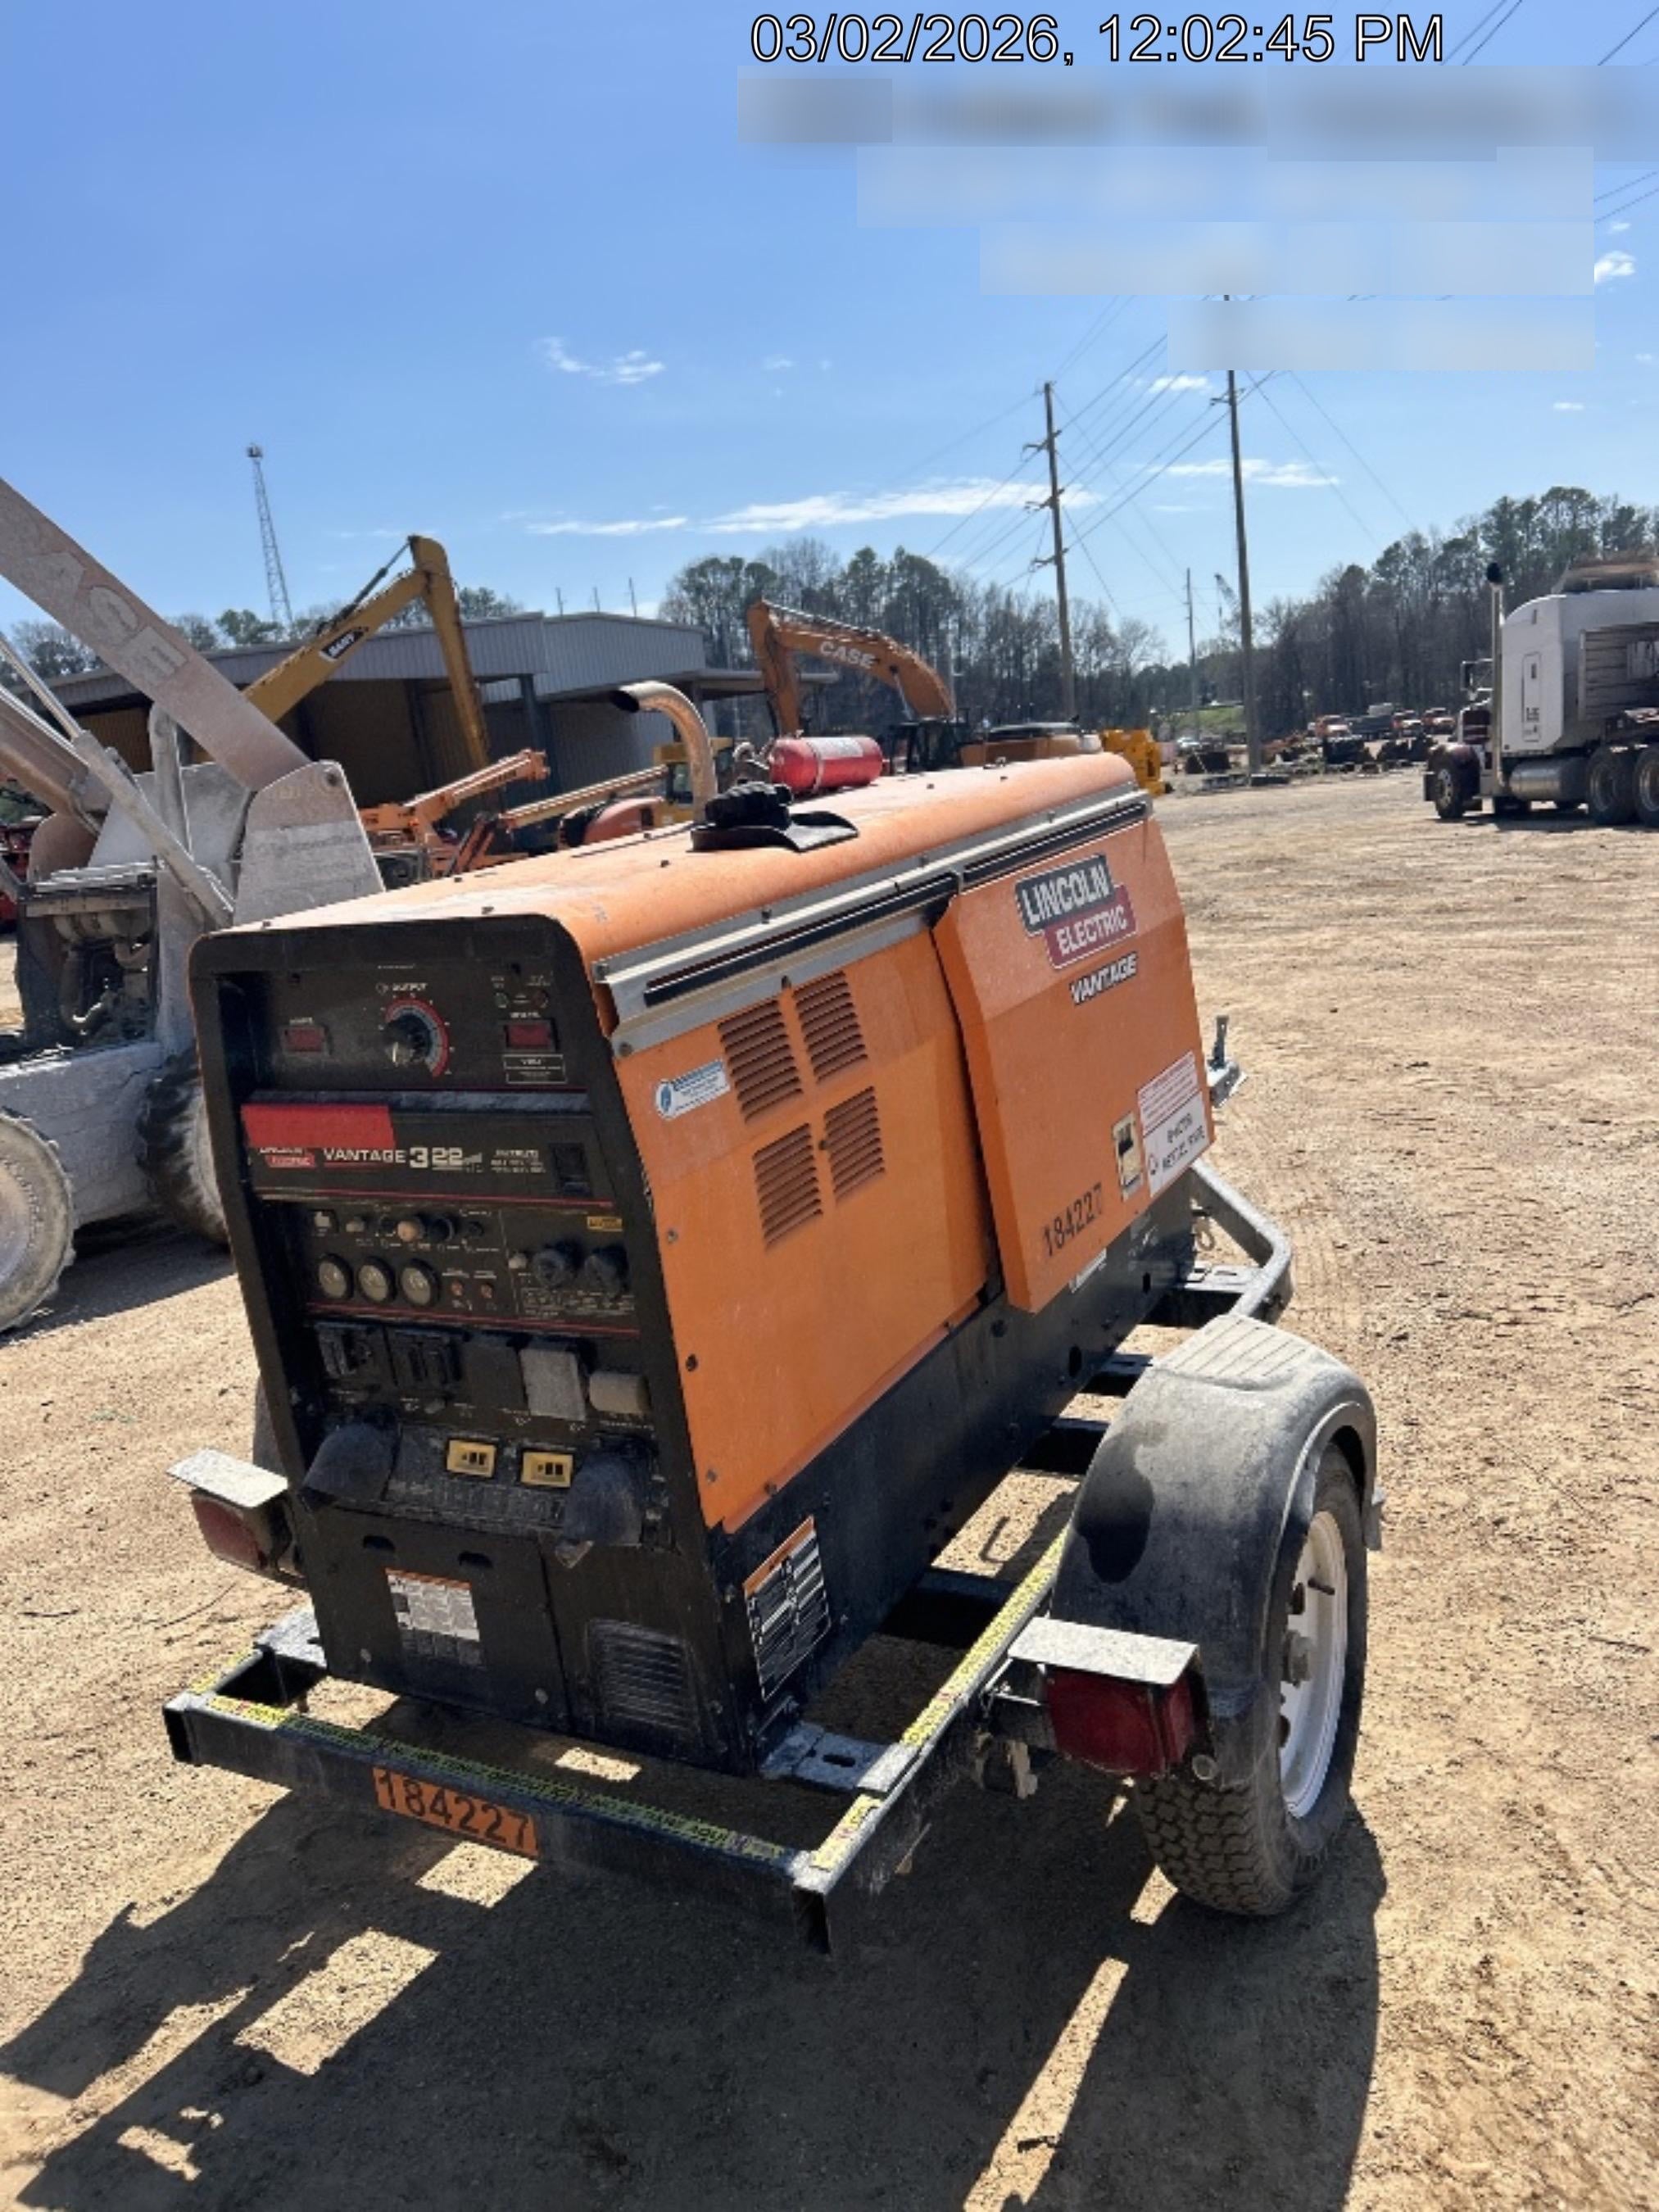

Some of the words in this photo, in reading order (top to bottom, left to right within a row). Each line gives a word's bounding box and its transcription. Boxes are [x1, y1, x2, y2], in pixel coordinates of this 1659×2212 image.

[819, 641, 876, 669] CASE
[1021, 863, 1111, 926] LINCOLN
[1055, 904, 1128, 957] ELECTRIC
[1070, 952, 1138, 1005] VANTAGE
[322, 1148, 407, 1164] VANTAGE
[409, 1147, 464, 1169] 322
[1041, 1182, 1104, 1257] 184227
[378, 1769, 529, 1848] 184227
